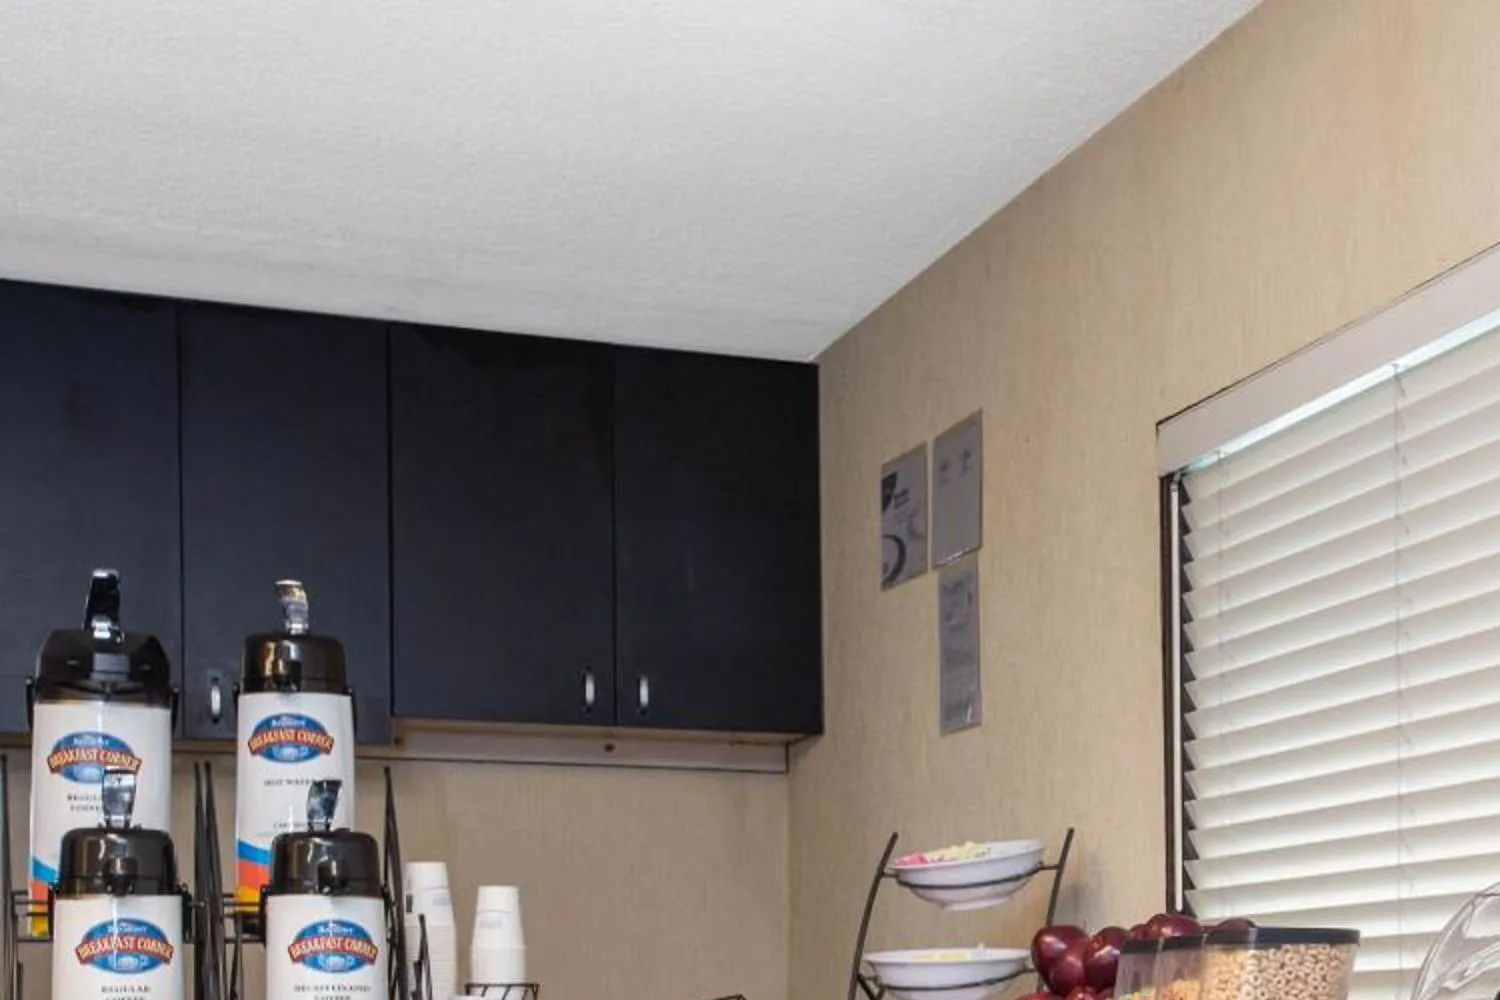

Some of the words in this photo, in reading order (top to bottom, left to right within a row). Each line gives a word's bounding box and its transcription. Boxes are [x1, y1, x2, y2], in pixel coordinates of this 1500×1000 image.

[79, 934, 135, 961] BREAKFAST
[137, 935, 174, 959] CORNER
[289, 935, 342, 960] BREAKFAST
